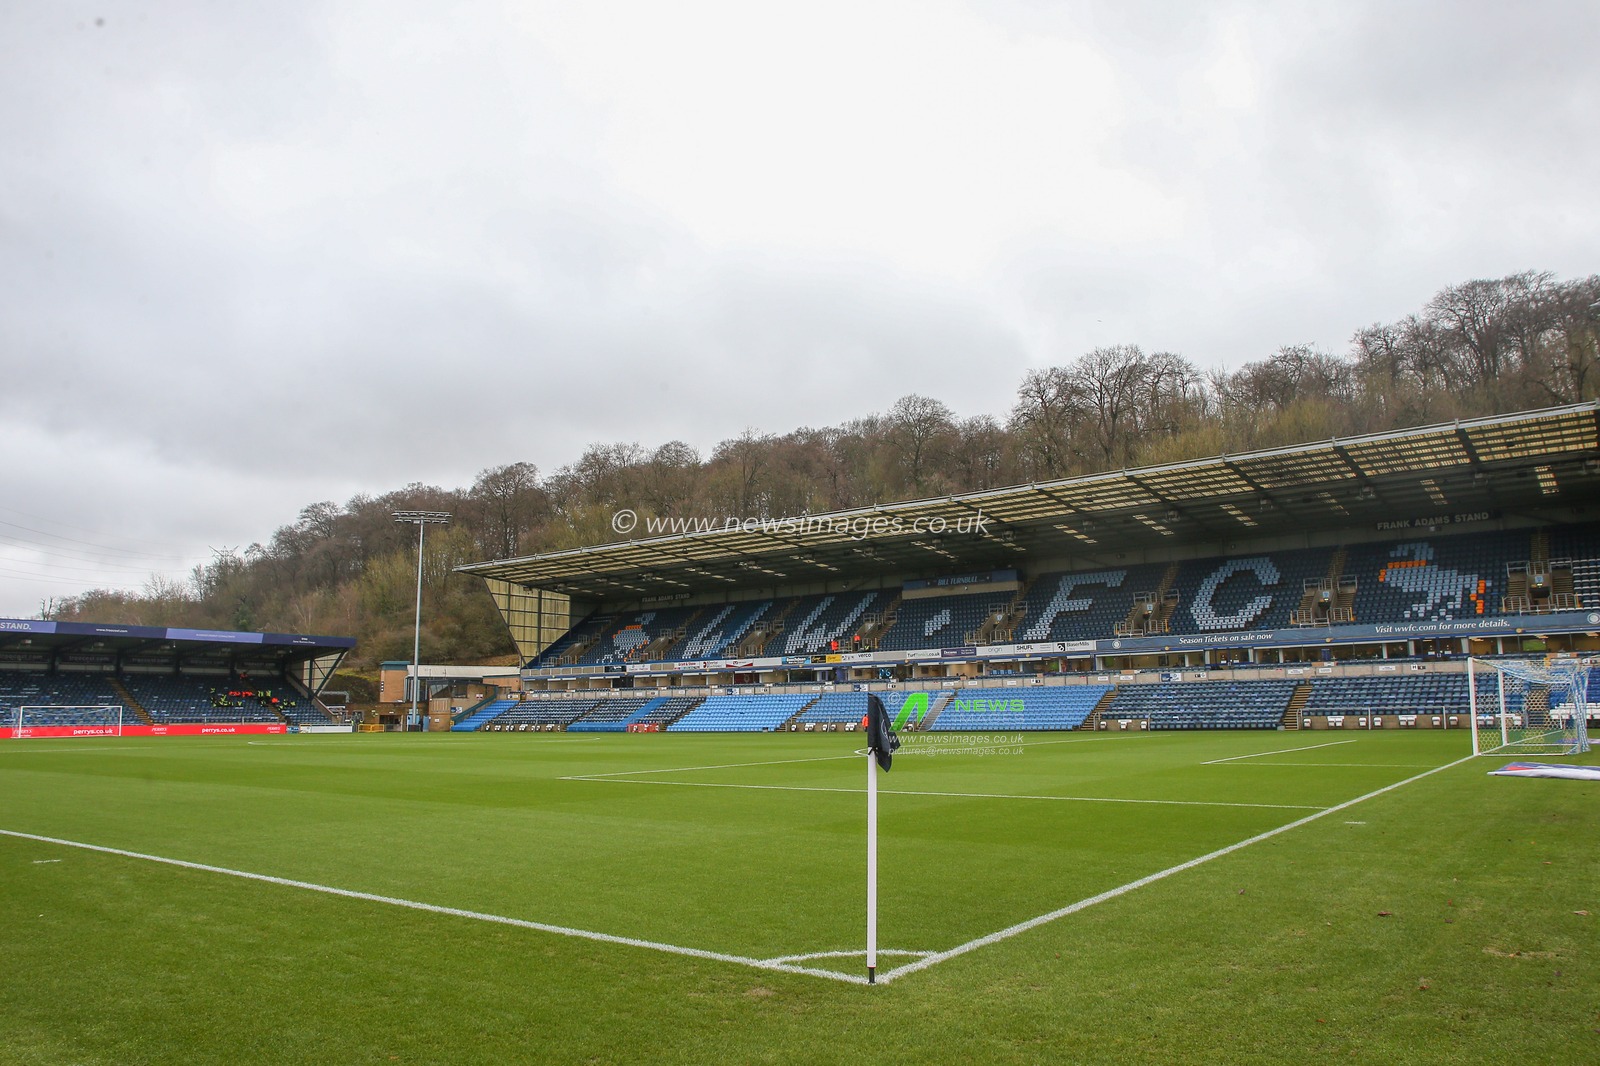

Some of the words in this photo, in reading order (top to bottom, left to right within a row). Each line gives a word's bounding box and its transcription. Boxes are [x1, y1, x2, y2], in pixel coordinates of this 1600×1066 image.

[1377, 520, 1410, 530] FRANK
[1415, 516, 1450, 527] ADAMS
[1455, 512, 1489, 522] STAND
[1375, 625, 1393, 633] Visit
[1394, 623, 1436, 633] wwfc.com
[1439, 622, 1451, 630] for
[1453, 622, 1477, 630] more
[1479, 619, 1510, 628] details.
[1179, 637, 1203, 645] Season
[1204, 635, 1228, 643] Tickets
[1240, 633, 1255, 641] sale
